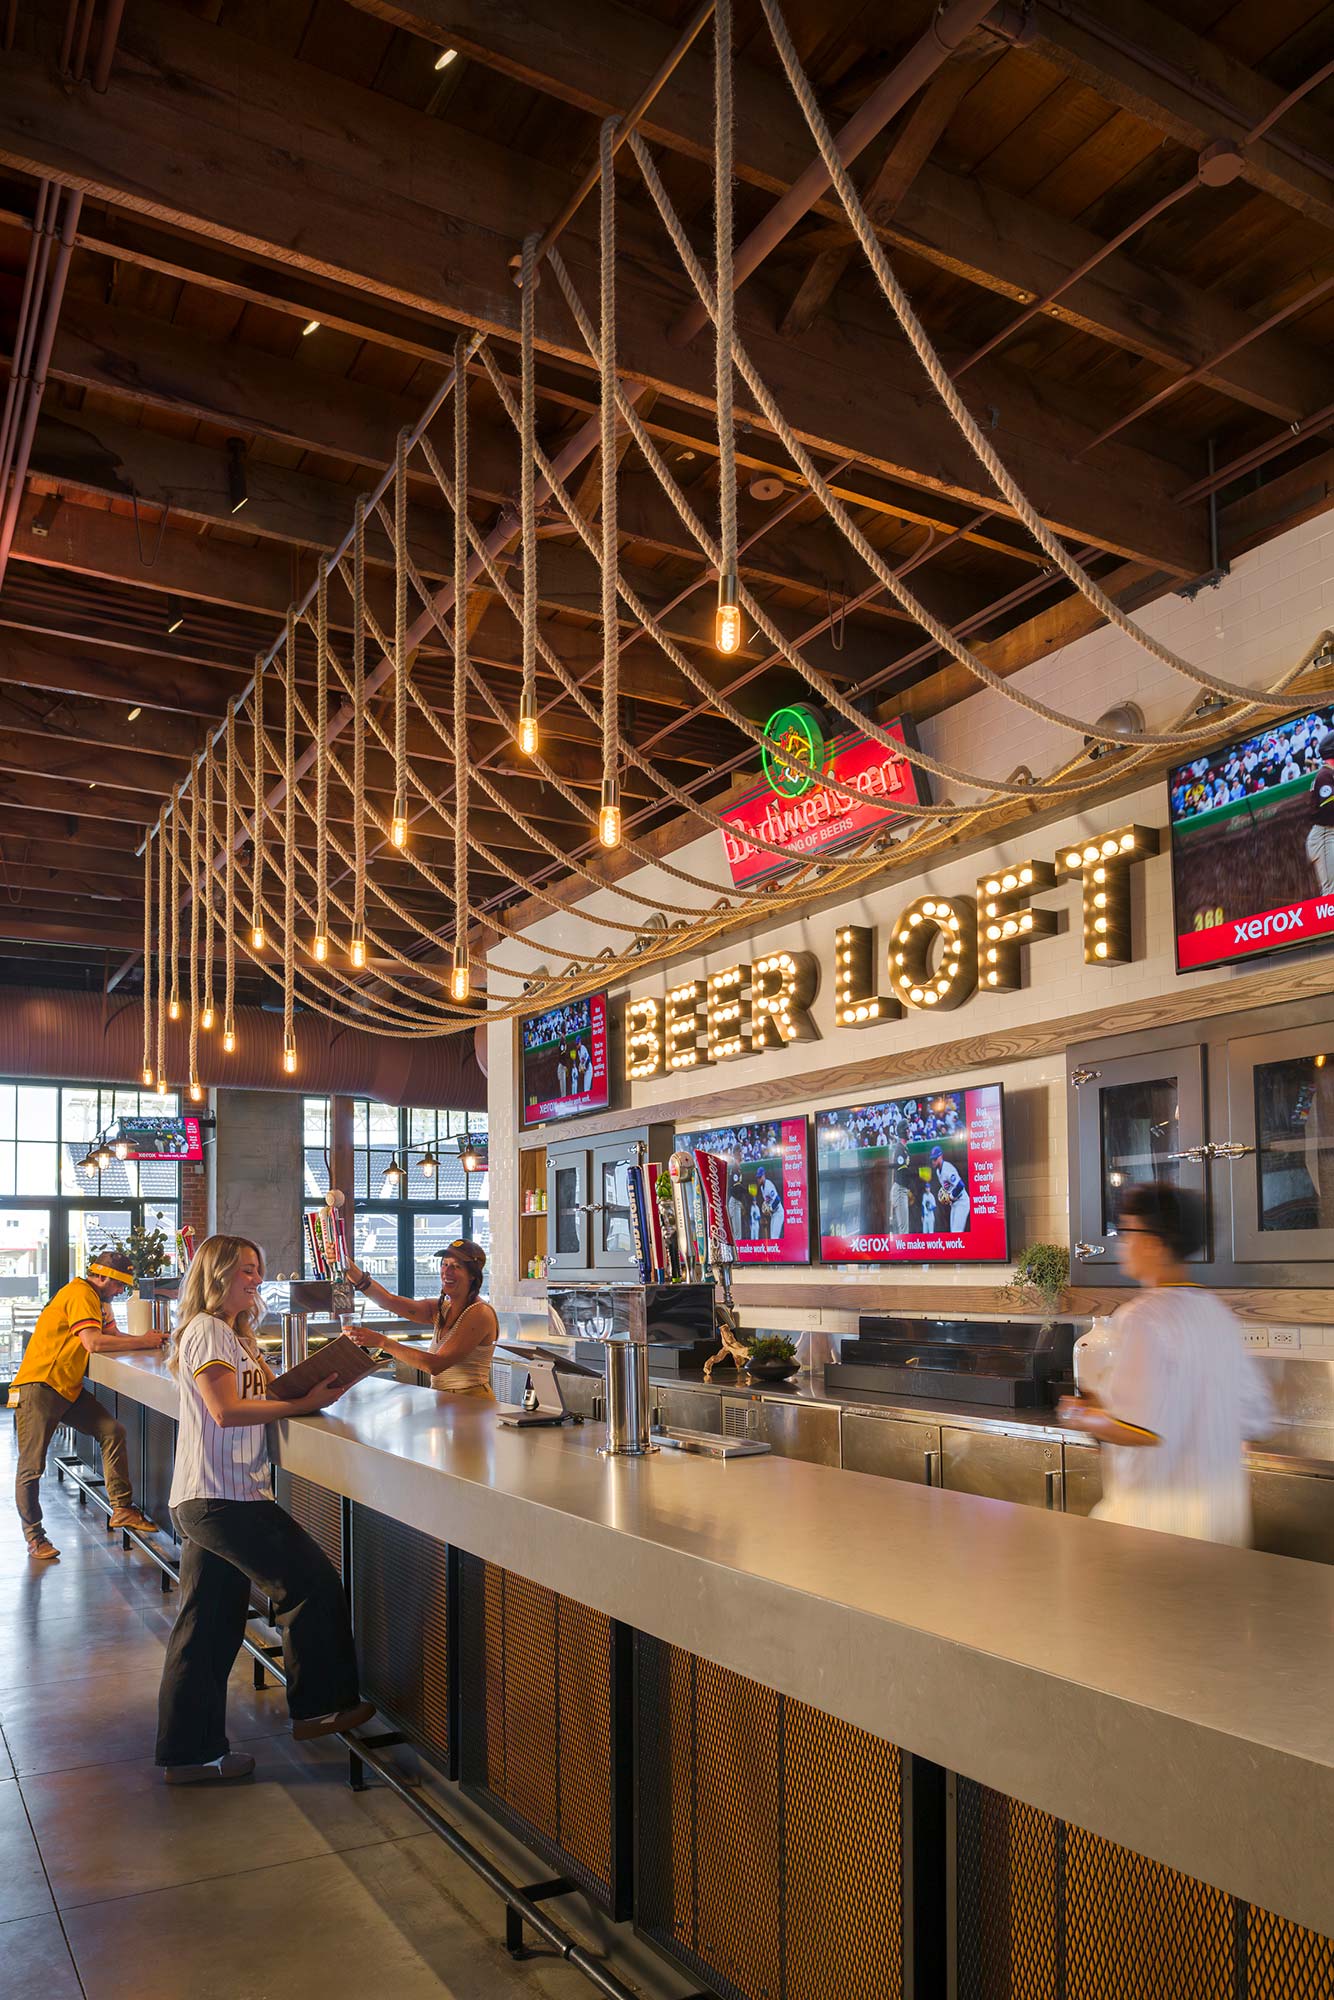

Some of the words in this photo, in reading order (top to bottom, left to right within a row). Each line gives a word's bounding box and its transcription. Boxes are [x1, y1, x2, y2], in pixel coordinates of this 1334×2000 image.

[805, 832, 818, 848] OF
[821, 817, 854, 842] BEERS
[1234, 907, 1304, 943] xerox
[625, 950, 822, 1081] BEER
[836, 824, 1160, 1028] LOFT
[973, 1171, 994, 1183] clearly
[974, 1161, 993, 1171] You're
[979, 1183, 990, 1192] not
[628, 1185, 639, 1229] LIGHT
[706, 1155, 728, 1249] Budweiser
[972, 1193, 997, 1205] working
[973, 1204, 986, 1214] with
[987, 1206, 997, 1214] us.
[634, 1230, 643, 1259] BUD
[851, 1237, 889, 1252] xerox
[895, 1239, 905, 1250] We
[907, 1238, 925, 1249] make
[927, 1238, 945, 1250] work,
[946, 1237, 965, 1249] work.
